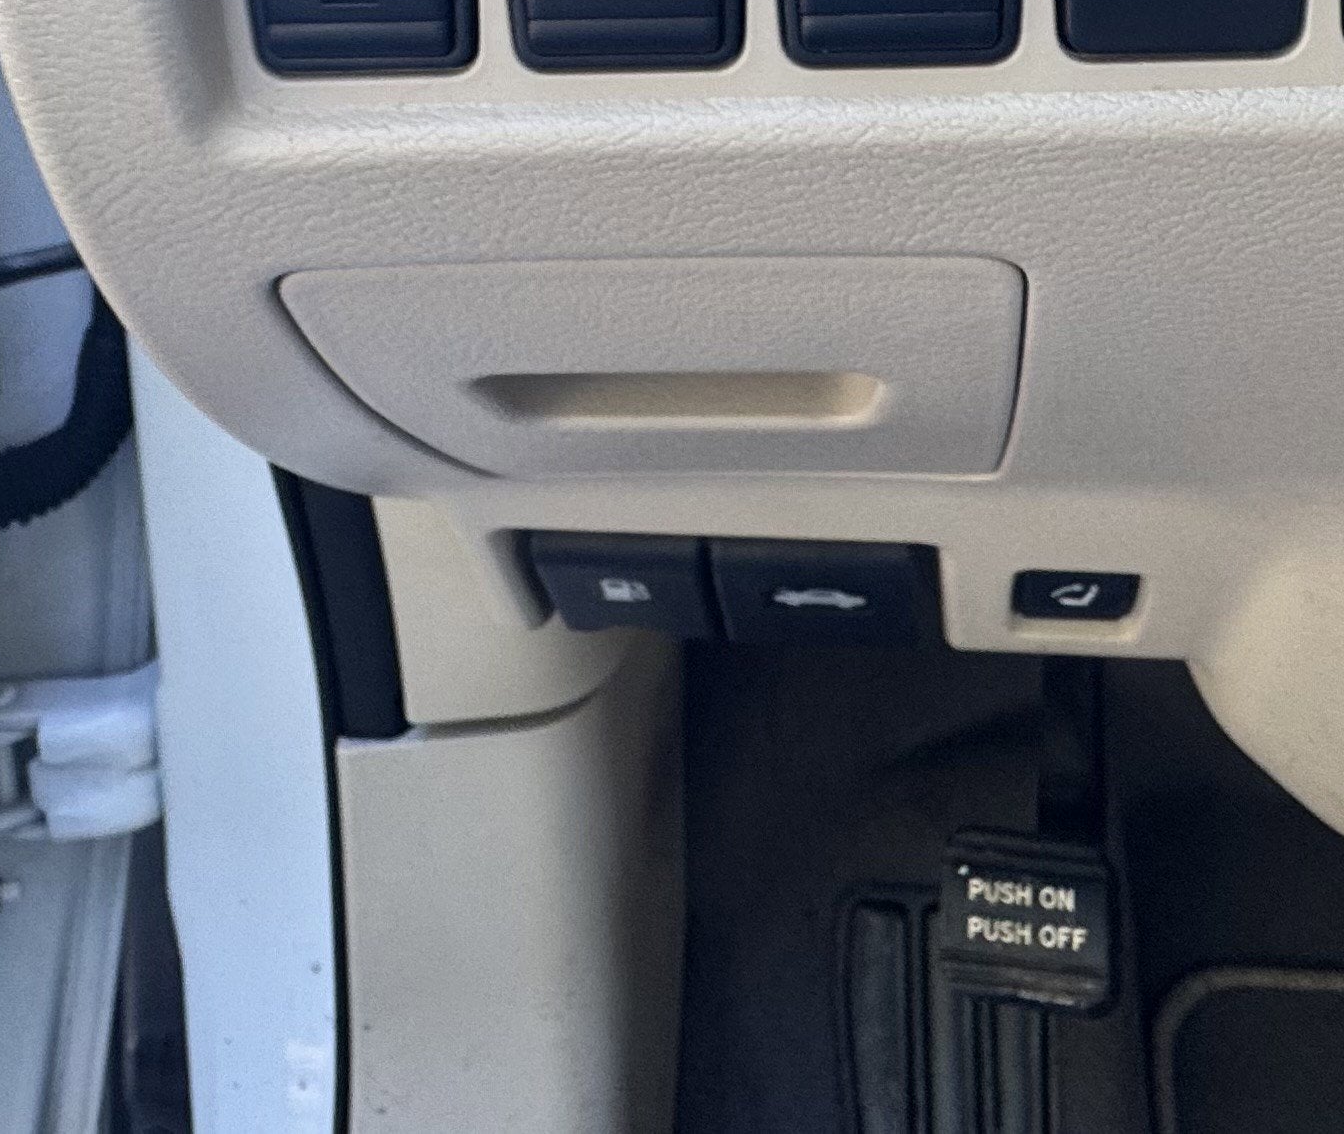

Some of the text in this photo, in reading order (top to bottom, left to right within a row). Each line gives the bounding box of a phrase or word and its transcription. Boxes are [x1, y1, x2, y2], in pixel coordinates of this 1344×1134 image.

[967, 877, 1076, 912] PUSH ON
[966, 915, 1088, 952] PUSH OFF
